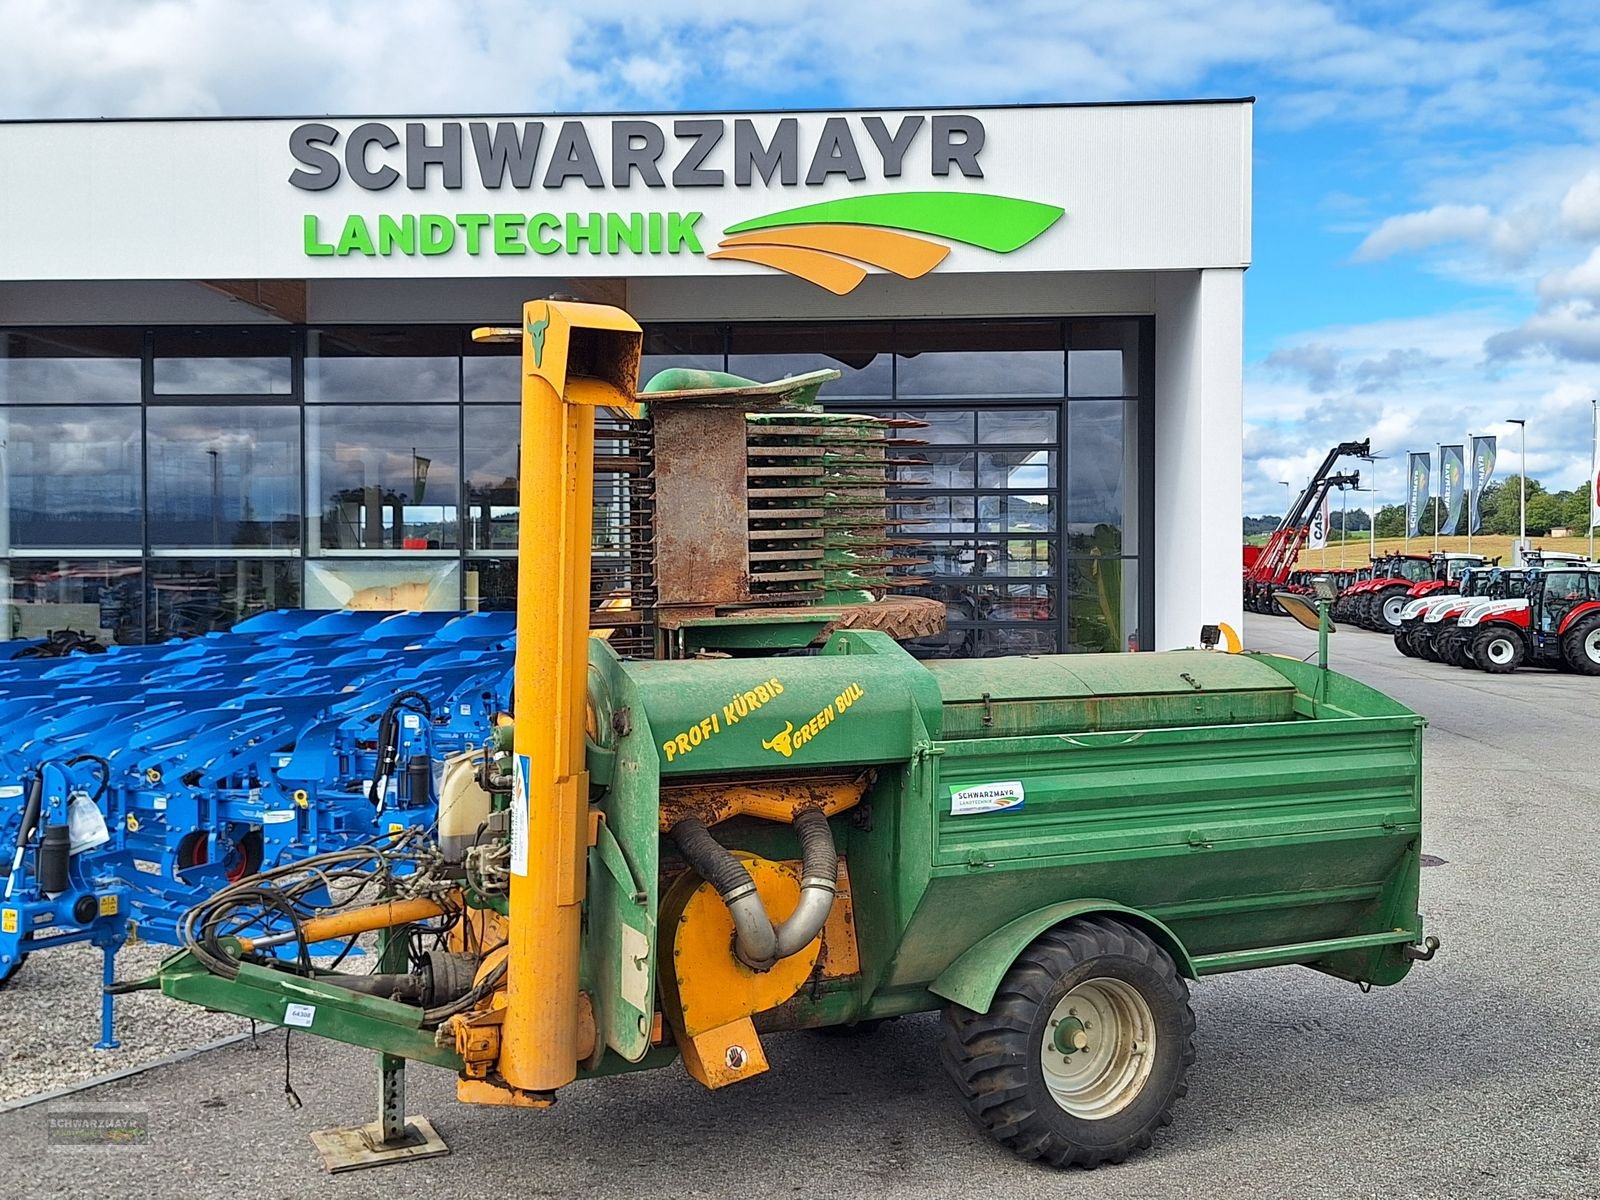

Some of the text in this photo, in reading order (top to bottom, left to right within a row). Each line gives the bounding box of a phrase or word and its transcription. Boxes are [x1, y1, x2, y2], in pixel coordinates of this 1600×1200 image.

[288, 113, 985, 192] SCHWARZMAYR
[303, 211, 705, 257] LANDTECHNIK
[1314, 508, 1323, 540] CAS
[662, 677, 785, 762] PROFI KÜRBIS
[792, 682, 864, 749] GREEN BULL
[958, 789, 1014, 799] SCHWARZMAYR
